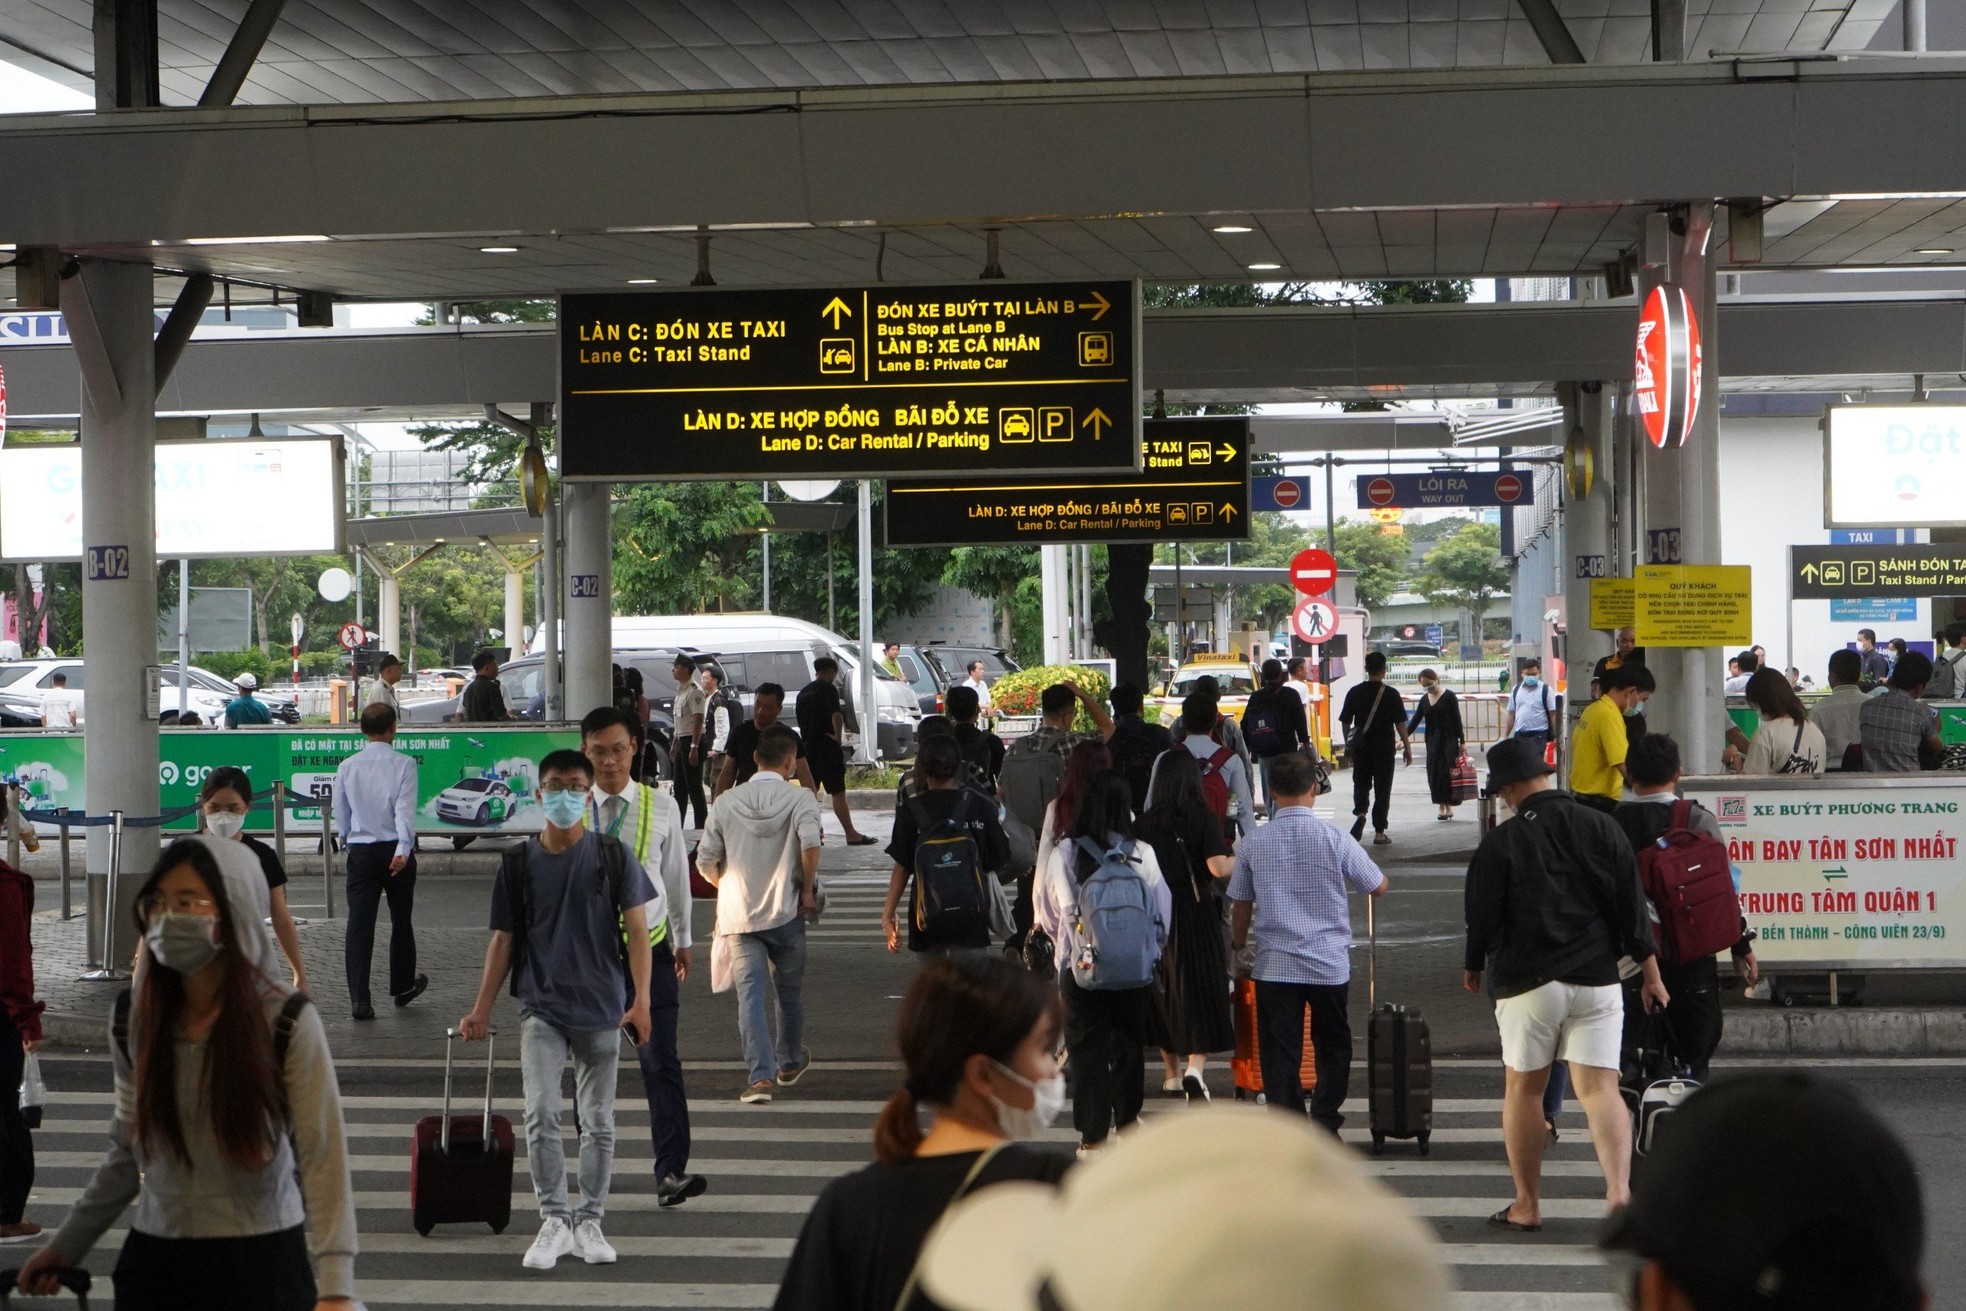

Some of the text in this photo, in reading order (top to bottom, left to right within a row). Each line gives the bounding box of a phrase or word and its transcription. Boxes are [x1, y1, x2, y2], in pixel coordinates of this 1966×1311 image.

[877, 297, 1075, 319] ĐÓN XE BUÝT TẠI LÀN B
[579, 318, 786, 341] LÀN C: ĐÓN XE TAXI
[878, 321, 1006, 338] Bus Stop at Lane B
[878, 334, 1040, 355] LÀN B: XE CÁ NHÂN
[580, 345, 750, 363] Lane C: Taxi Stand
[878, 356, 1008, 372] Lane B: Private Car
[684, 400, 989, 431] LÀN D: XE HỢP ĐỒNG BÃI ĐỖ XE
[761, 436, 801, 451] Lane
[805, 435, 823, 450] D:
[828, 434, 857, 450] Car
[861, 432, 912, 449] Rental
[927, 431, 989, 451] Parking
[1142, 441, 1182, 453] E TAXI
[1149, 456, 1182, 467] Stand
[1448, 478, 1468, 490] RA
[1422, 494, 1465, 503] WAY OUT
[968, 502, 992, 517] LÀN
[995, 505, 1007, 517] D:
[1011, 505, 1026, 517] XE
[1029, 503, 1054, 518] HỢP
[1057, 500, 1092, 516] ĐỒNG
[1102, 501, 1122, 515] BÃI
[1125, 499, 1143, 515] ĐỖ
[1145, 503, 1161, 514] XE
[1017, 519, 1043, 531] Lane
[1046, 519, 1057, 530] D:
[1059, 519, 1078, 530] Car
[1080, 518, 1113, 530] Rental
[1122, 517, 1161, 531] Parking
[1848, 533, 1873, 543] TAXI
[89, 549, 128, 578] B-02
[1577, 557, 1605, 577] C-03
[1879, 557, 1966, 571] SẢNH ĐÓN TA
[572, 577, 598, 596] C-02
[1879, 575, 1901, 585] Taxi
[1905, 575, 1937, 585] Stand
[1946, 575, 1966, 585] Par
[1197, 653, 1236, 662] Vinataxi
[291, 738, 302, 751] ĐÃ
[305, 738, 316, 751] CÓ
[318, 738, 336, 752] MẶT
[339, 740, 352, 752] TẠI
[409, 738, 426, 750] SƠN
[428, 736, 450, 750] NHẤT
[292, 755, 307, 768] ĐẶT
[310, 756, 320, 766] XE
[1753, 802, 1958, 816] XE BUÝT PHƯƠNG TRANG
[1728, 830, 1957, 861] ÂN BAY TÂN SƠN NHẤT
[1811, 888, 1856, 912] TÂM
[1865, 887, 1919, 916] QUẬN
[1926, 891, 1936, 911] 1
[1762, 923, 1785, 940] BẾN
[1790, 924, 1828, 939] THÀNH
[1844, 923, 1877, 939] CÔNG
[1881, 922, 1910, 938] VIÊN
[1913, 924, 1945, 939] 23/9)
